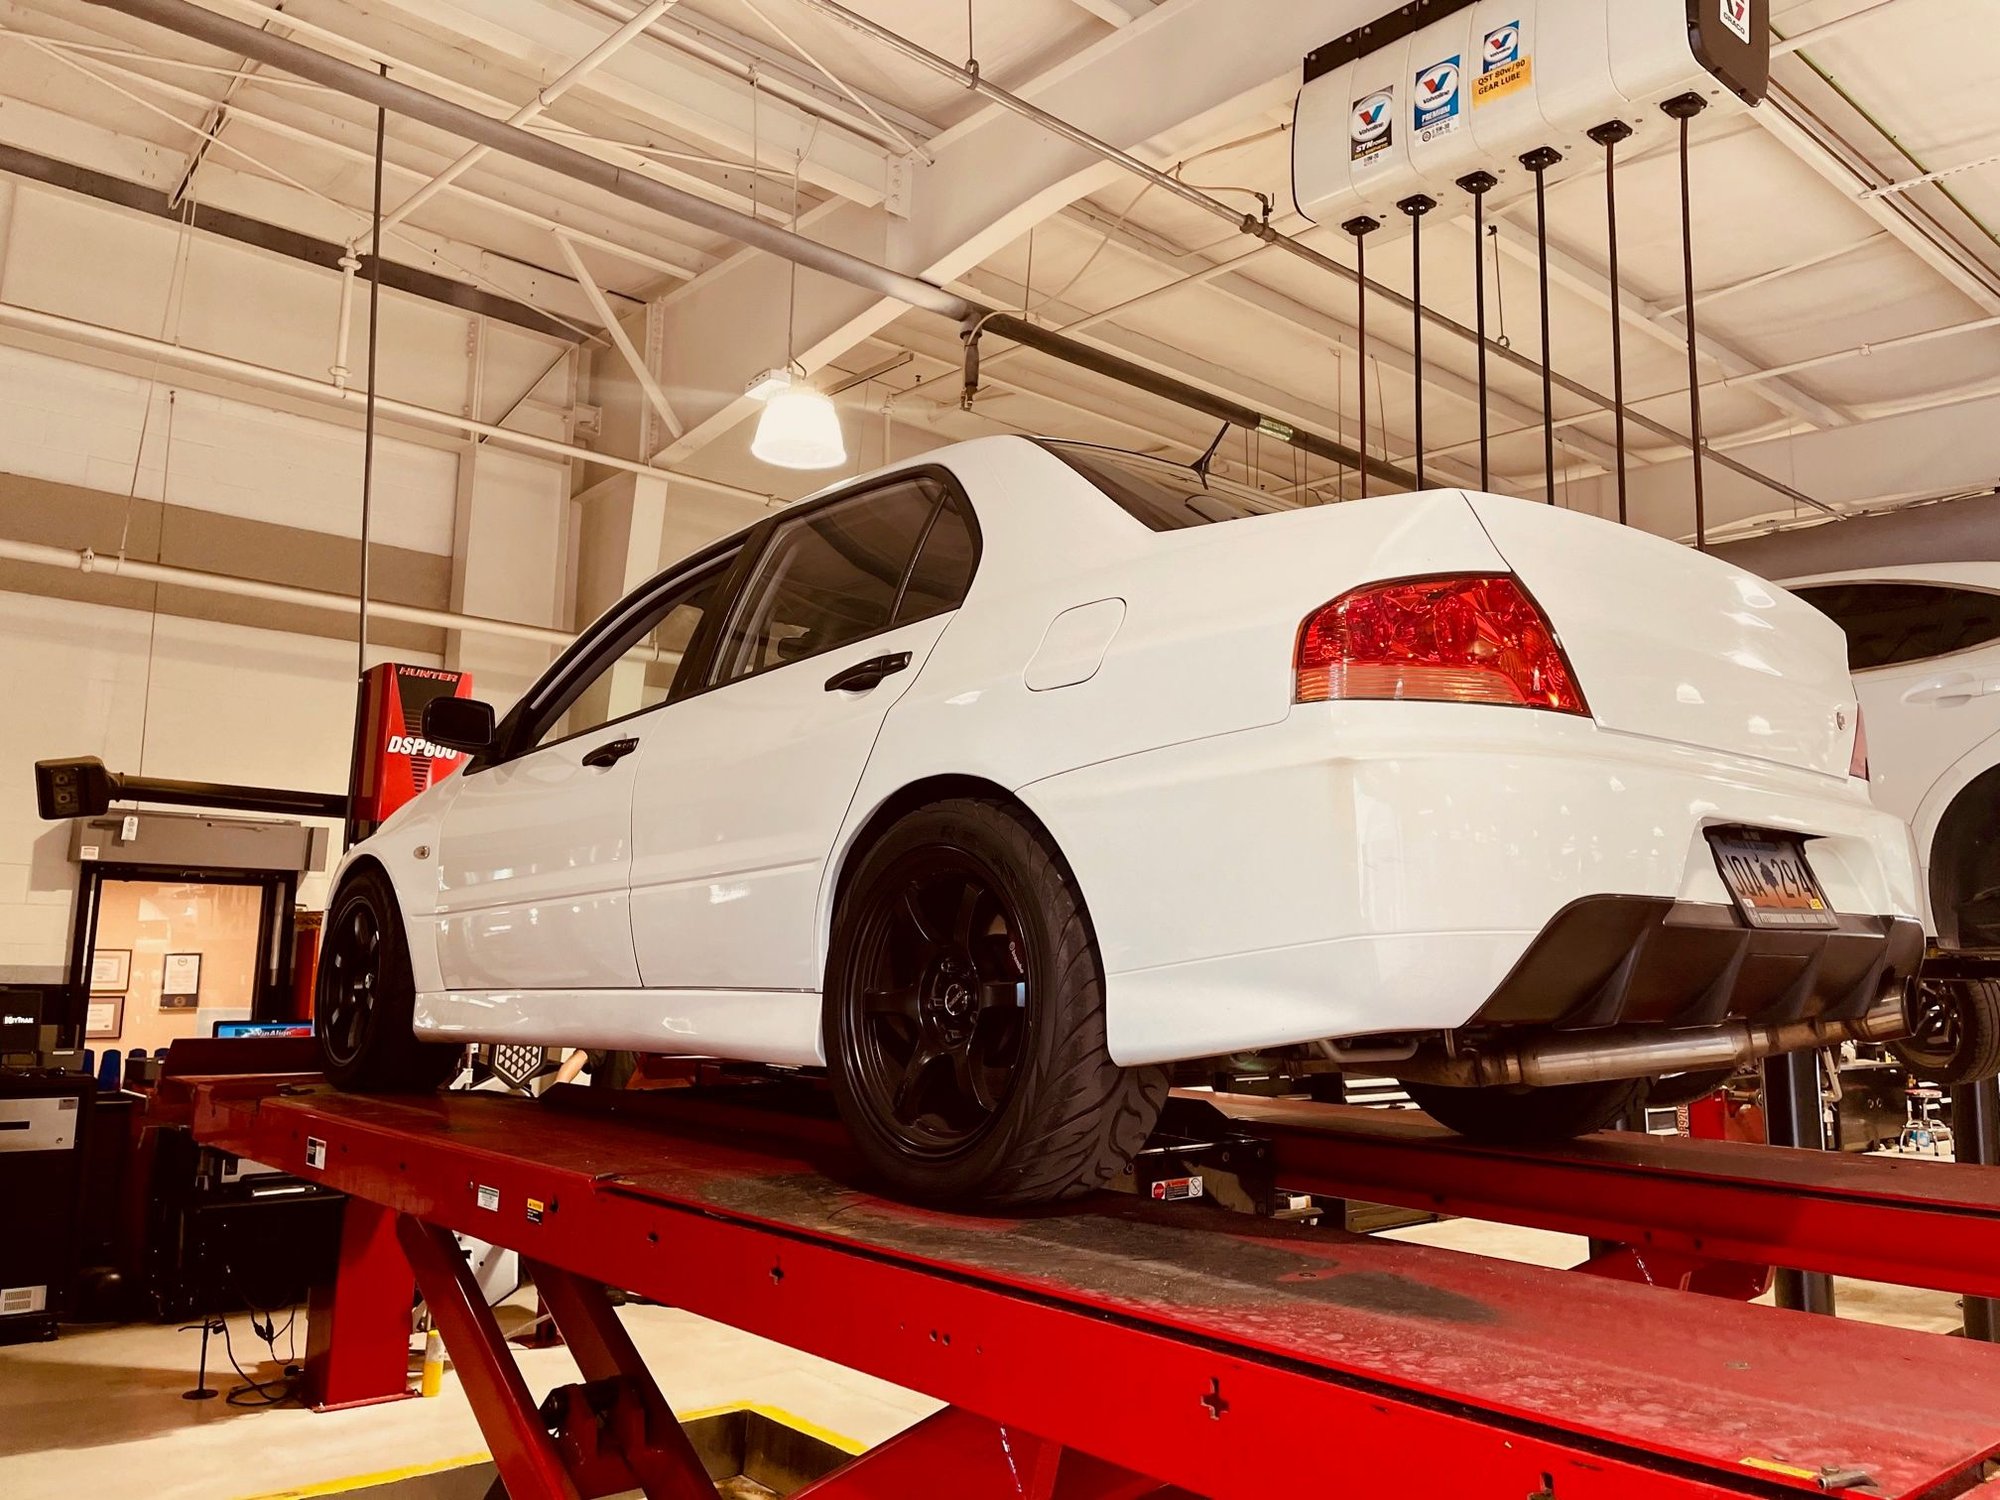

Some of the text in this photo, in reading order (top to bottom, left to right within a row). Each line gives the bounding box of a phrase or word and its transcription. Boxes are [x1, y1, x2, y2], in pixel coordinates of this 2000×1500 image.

[1723, 12, 1746, 35] GRACO
[1478, 73, 1493, 86] QST
[1478, 72, 1521, 95] GEAR LUBE
[1422, 90, 1450, 104] Valvoline
[1358, 121, 1384, 136] Valvoline
[399, 666, 458, 682] HUNTER
[1770, 858, 1816, 899] 294
